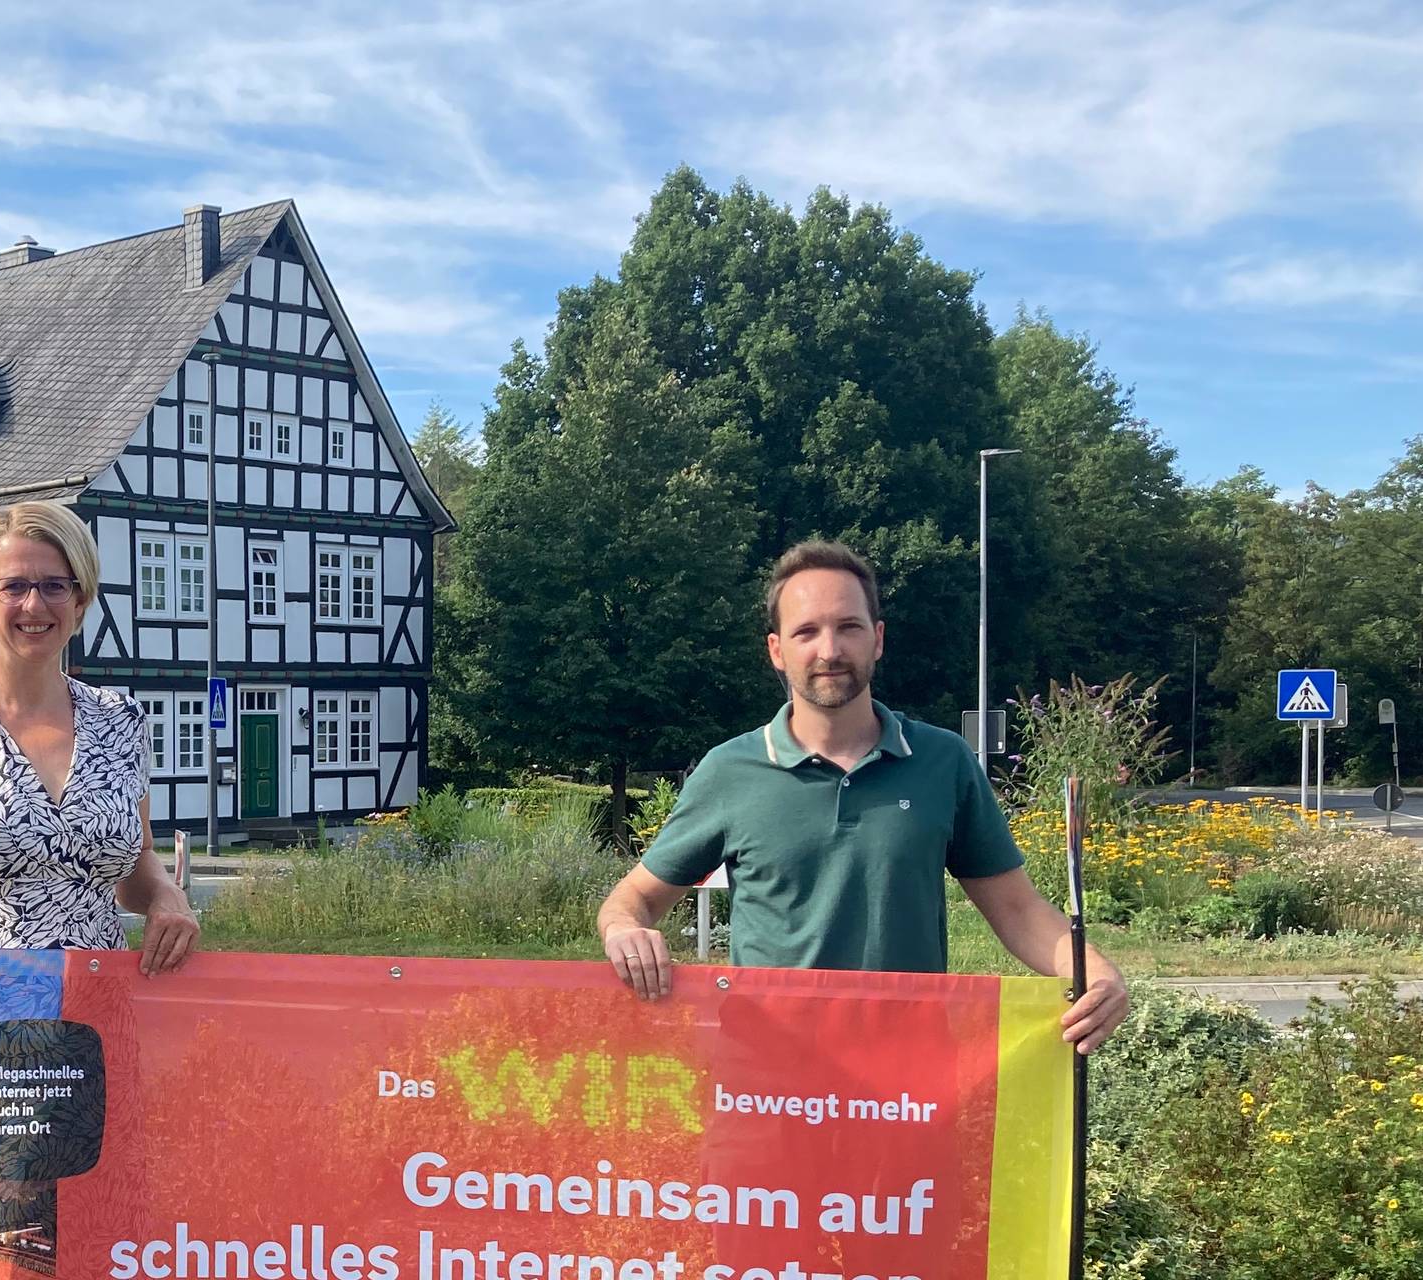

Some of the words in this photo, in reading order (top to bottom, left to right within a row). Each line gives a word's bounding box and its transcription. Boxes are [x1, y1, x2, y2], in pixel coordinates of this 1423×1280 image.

[42, 1084, 72, 1101] jetzt
[378, 1070, 436, 1099] Das
[439, 1040, 706, 1135] WIR
[714, 1083, 840, 1126] bewegt
[847, 1096, 938, 1123] mehr
[22, 1102, 34, 1116] in
[29, 1120, 51, 1134] Ort
[402, 1151, 800, 1229] Gemeinsam
[817, 1178, 935, 1236] auf
[108, 1222, 400, 1280] schnelles
[418, 1230, 685, 1280] Internet
